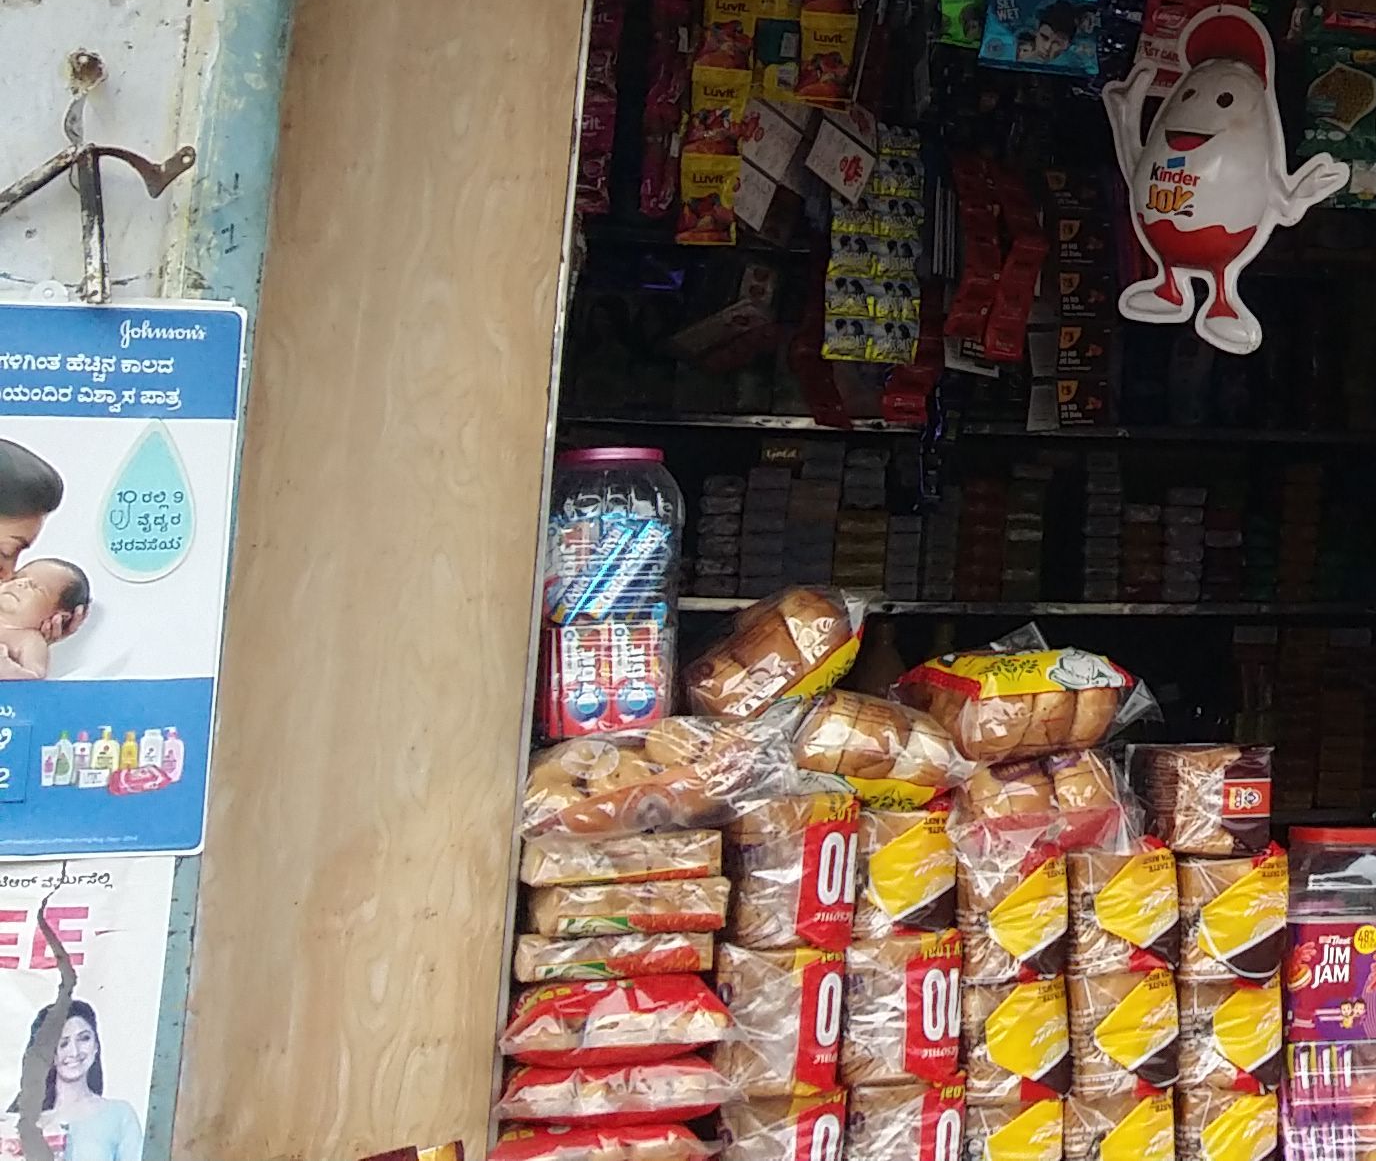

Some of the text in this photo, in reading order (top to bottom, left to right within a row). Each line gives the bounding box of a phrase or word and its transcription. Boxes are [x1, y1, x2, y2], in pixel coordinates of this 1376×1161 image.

[1150, 162, 1200, 187] Kinder
[120, 320, 207, 348] Johnson's
[1321, 946, 1351, 967] JIM
[1310, 965, 1350, 989] JAM
